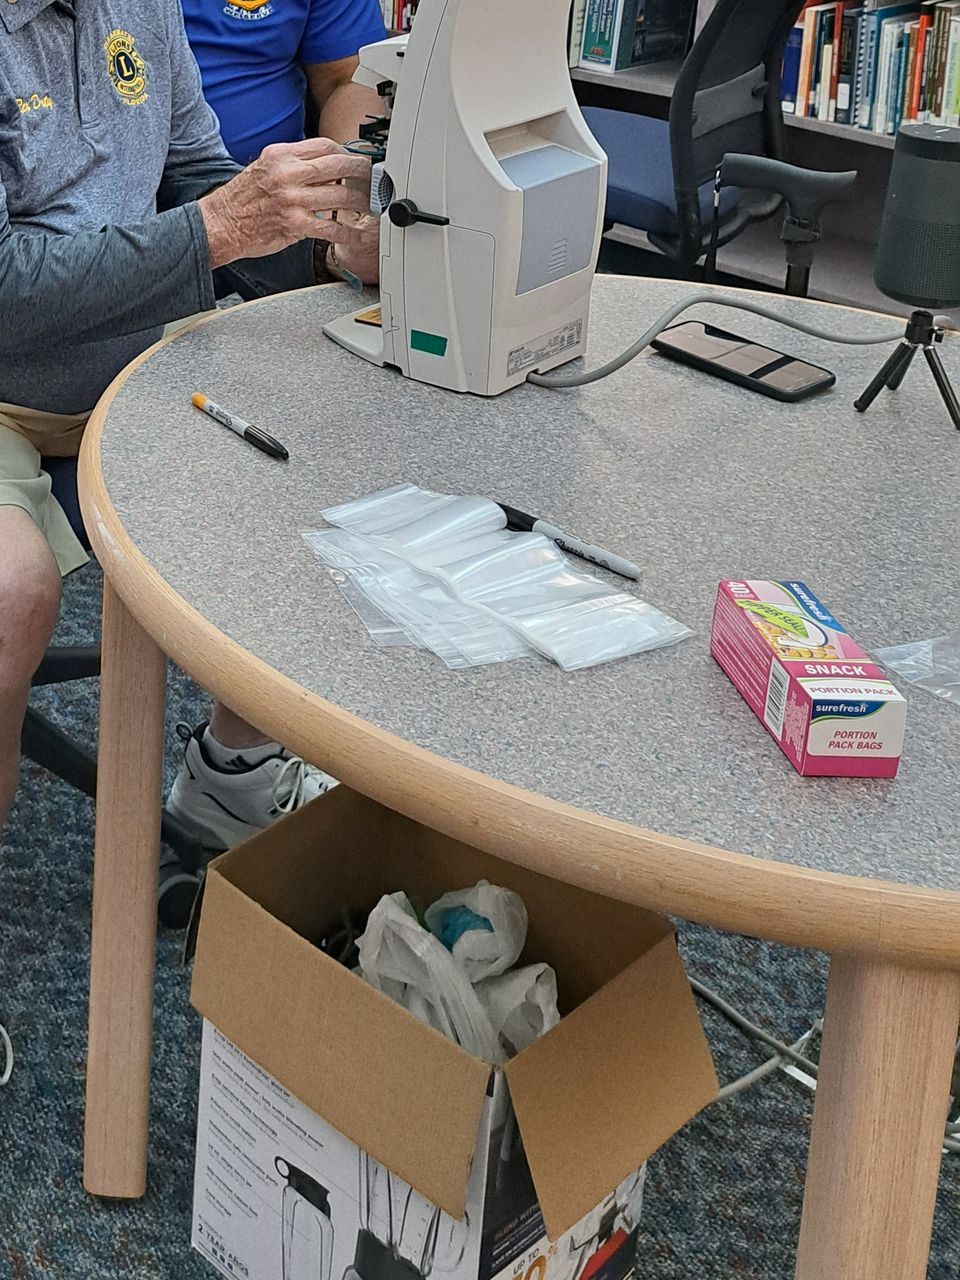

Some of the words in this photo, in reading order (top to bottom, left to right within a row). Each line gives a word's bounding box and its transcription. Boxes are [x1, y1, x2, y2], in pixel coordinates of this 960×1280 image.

[110, 39, 131, 53] LIONS
[118, 55, 134, 77] L
[727, 581, 750, 594] 40
[789, 582, 831, 623] surefresh
[804, 664, 868, 676] SNACK
[809, 687, 863, 695] PORTION
[864, 688, 898, 696] PACK
[815, 703, 867, 713] surefresh
[834, 730, 878, 739] PORTION
[828, 741, 853, 750] PACK
[856, 741, 883, 750] BAGS
[513, 1259, 526, 1275] UP
[527, 1247, 540, 1263] TO
